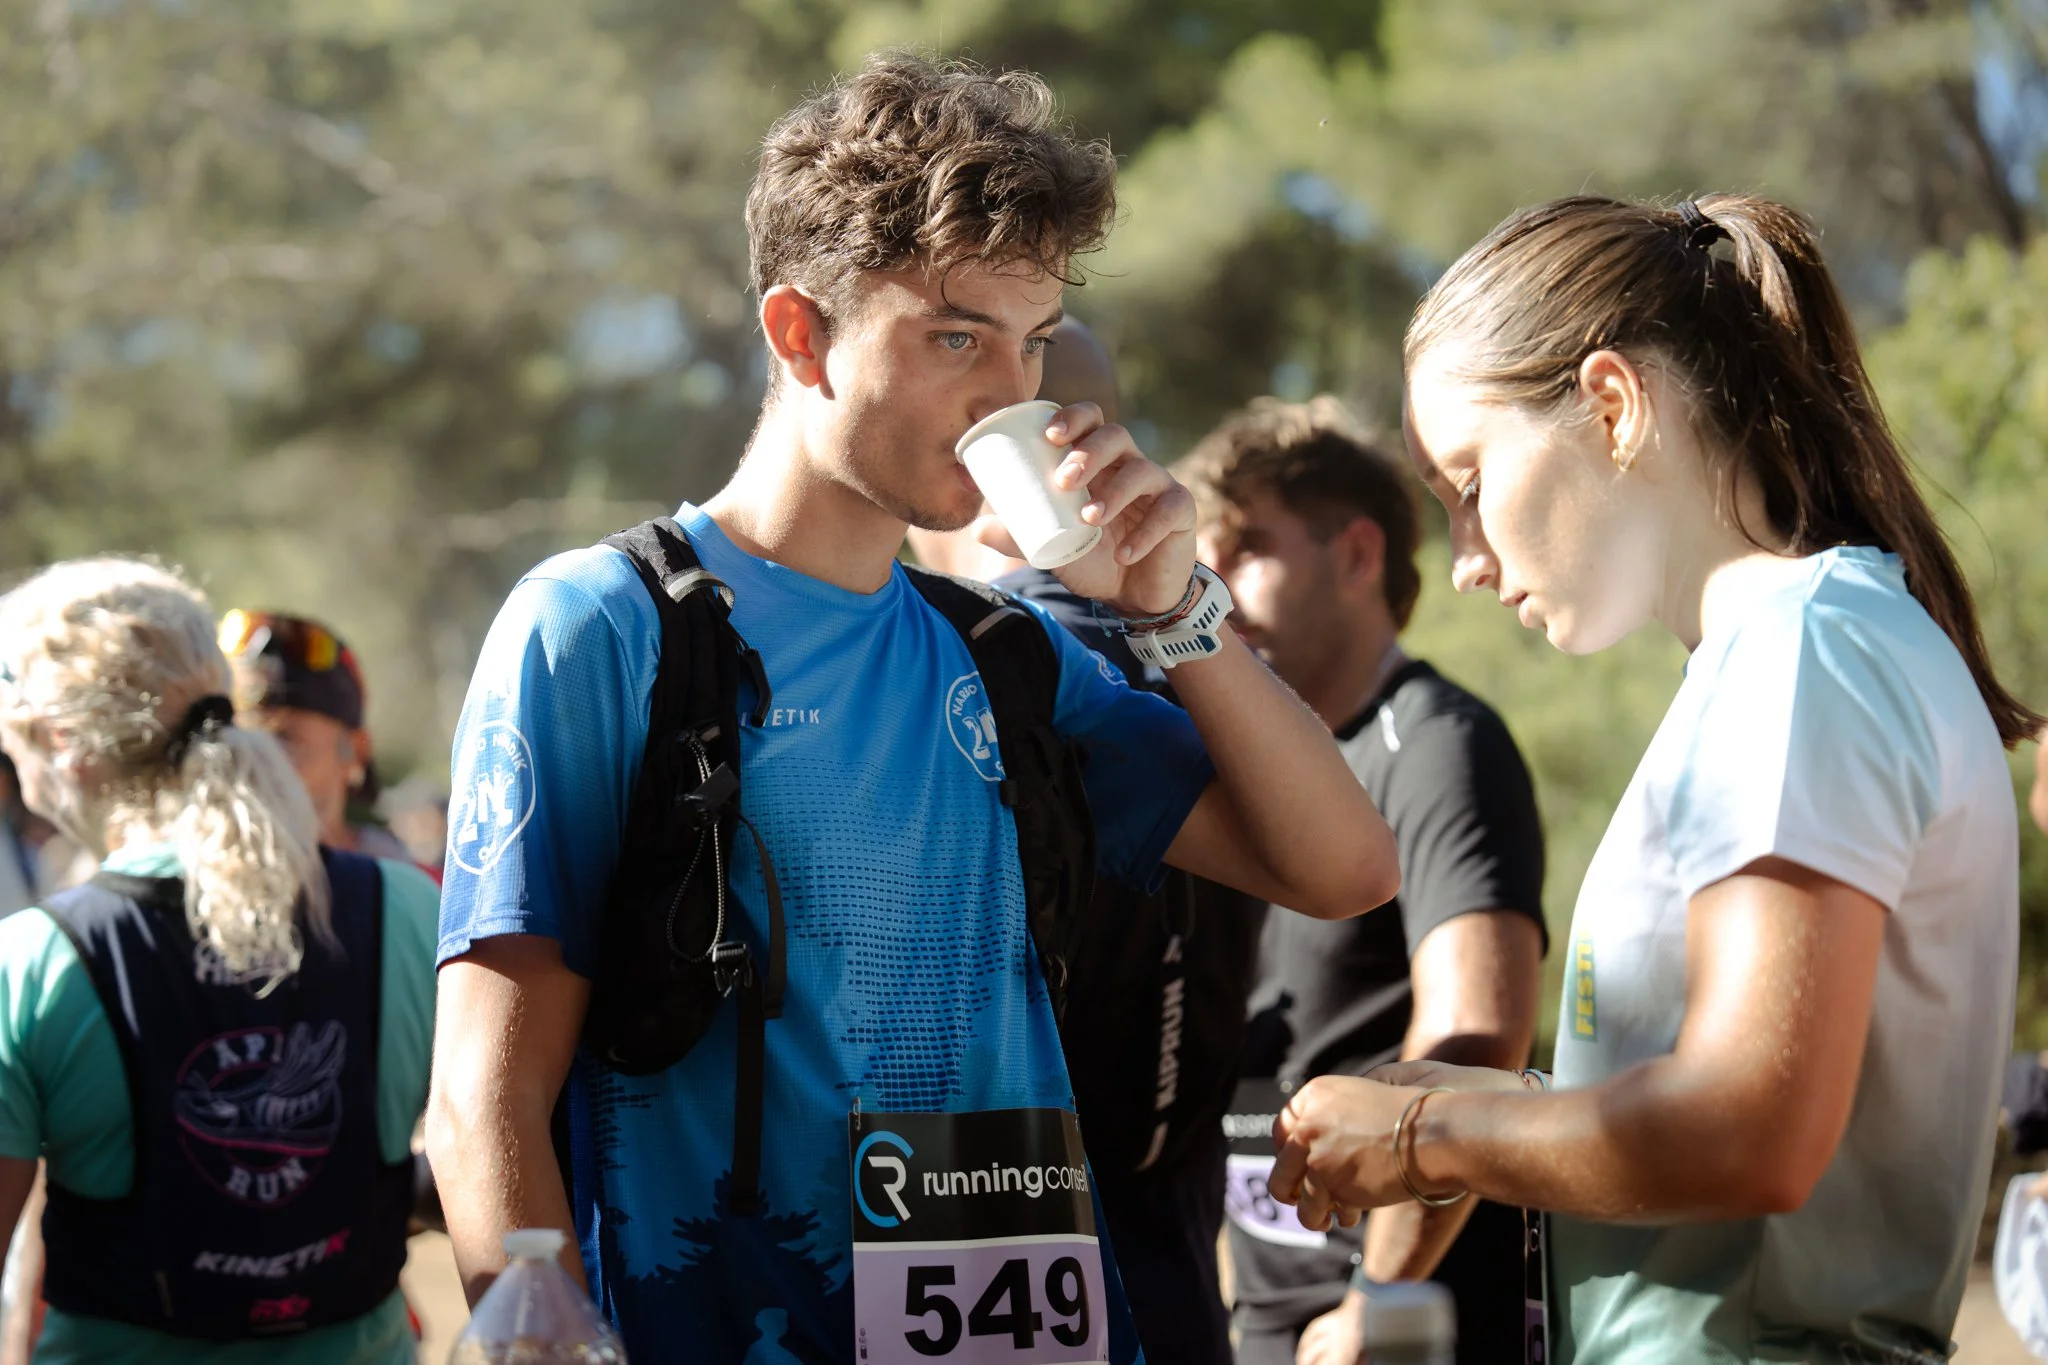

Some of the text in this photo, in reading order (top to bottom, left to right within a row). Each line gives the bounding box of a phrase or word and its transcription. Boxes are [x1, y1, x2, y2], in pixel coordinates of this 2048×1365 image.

[952, 684, 978, 717] NARIO
[226, 1156, 310, 1202] RUN
[904, 1256, 1090, 1356] 549
